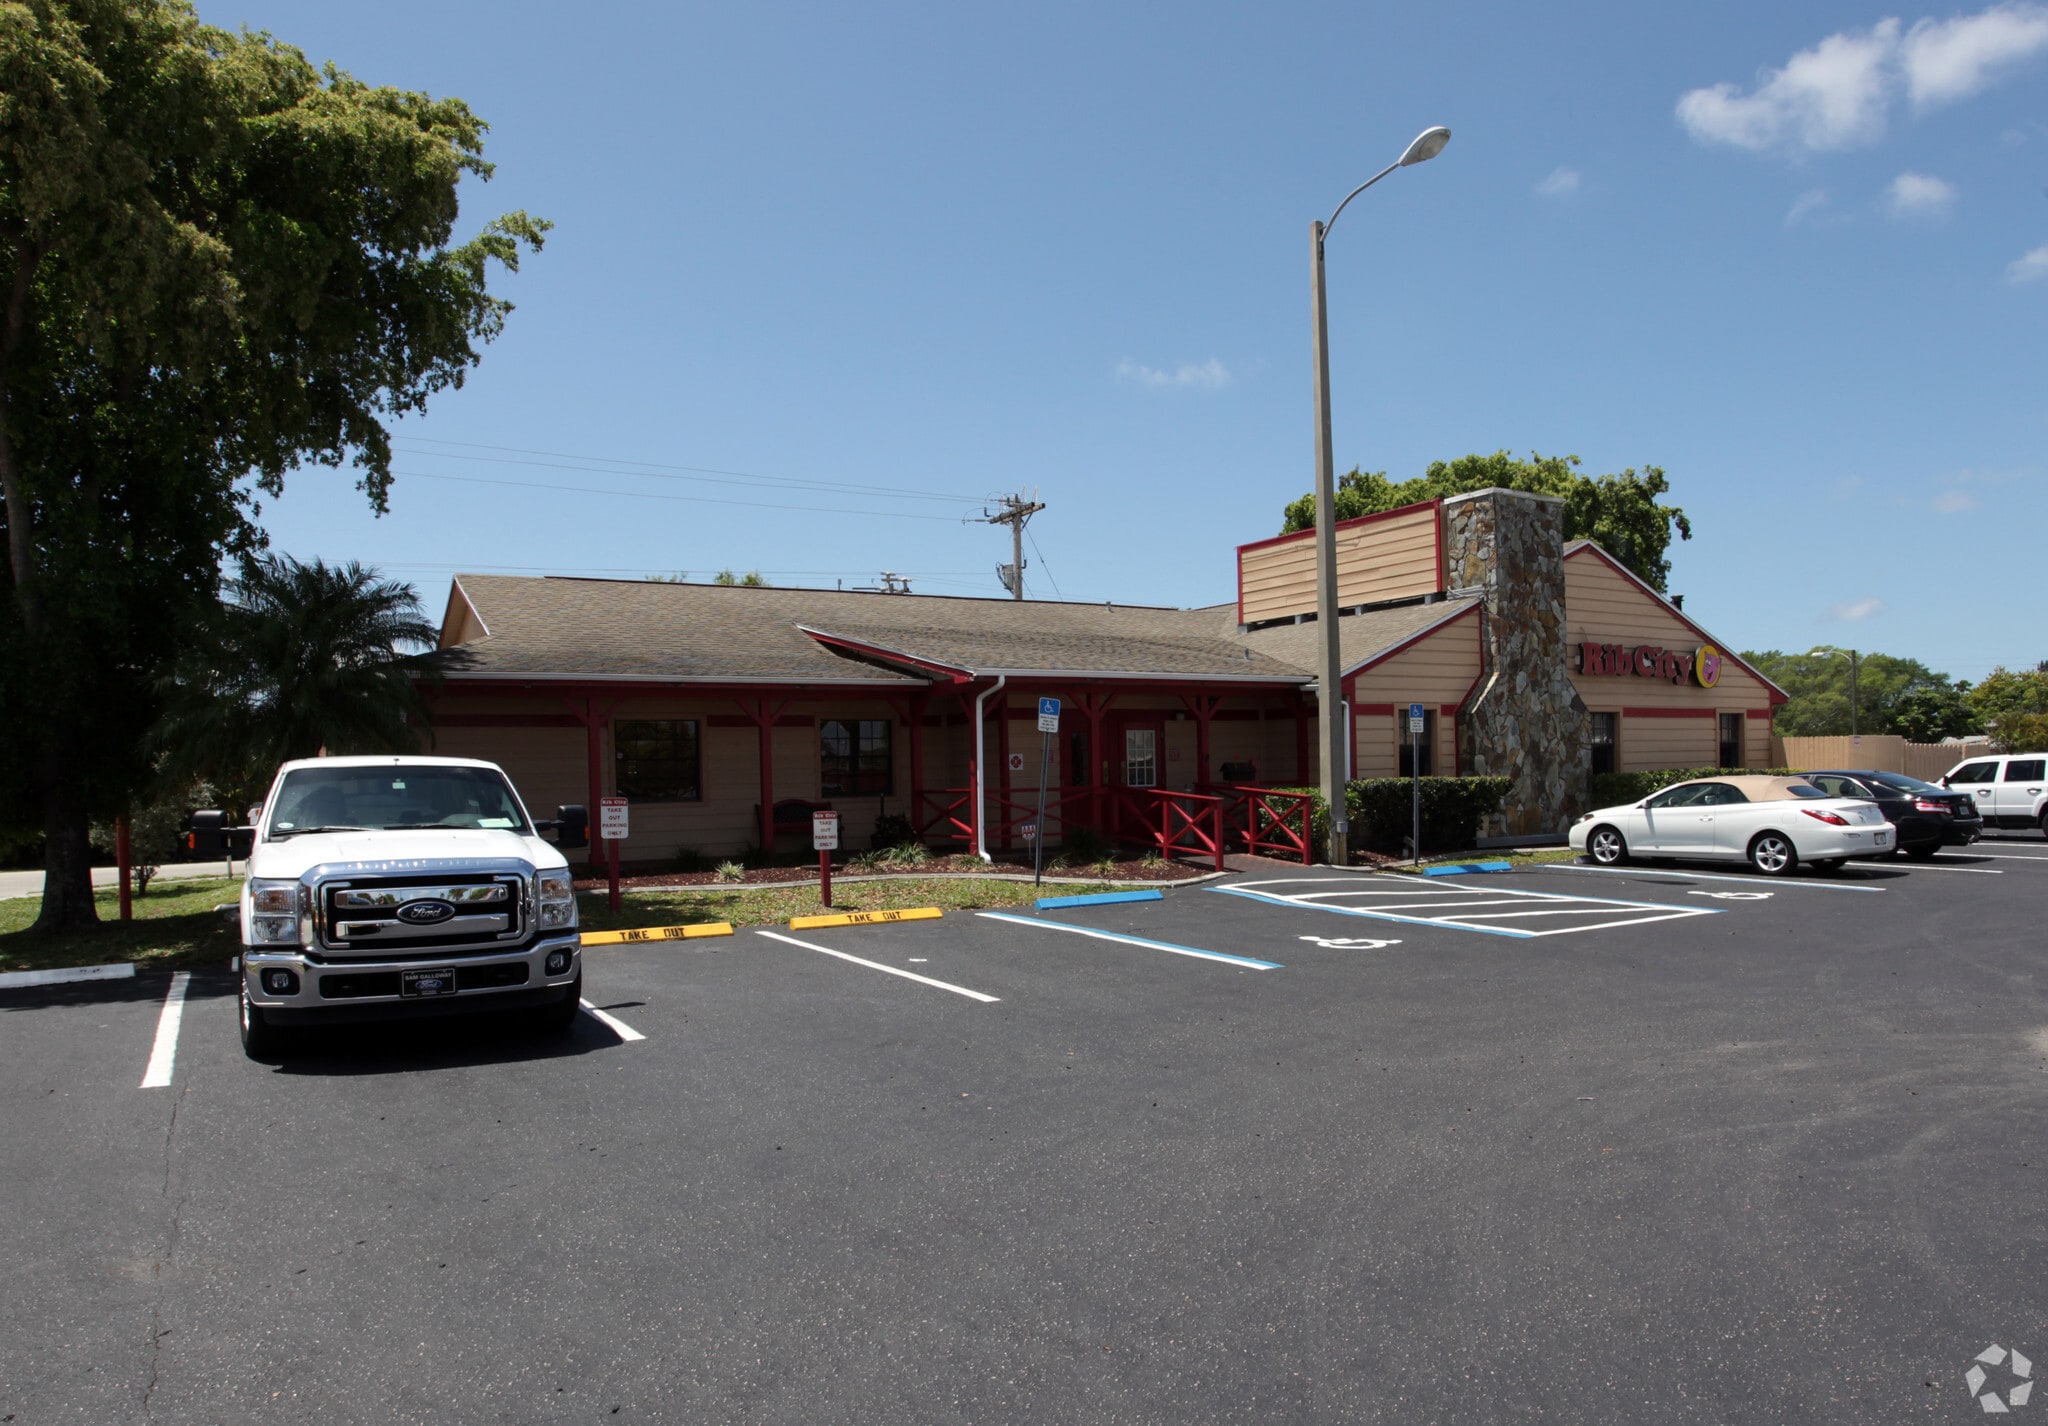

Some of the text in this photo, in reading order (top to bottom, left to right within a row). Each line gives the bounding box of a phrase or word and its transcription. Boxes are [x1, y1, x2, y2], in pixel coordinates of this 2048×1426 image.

[1581, 642, 1694, 686] Rib City
[410, 905, 442, 918] Ford
[847, 911, 901, 922] TAKE OUT
[619, 927, 684, 940] TAKE OUT
